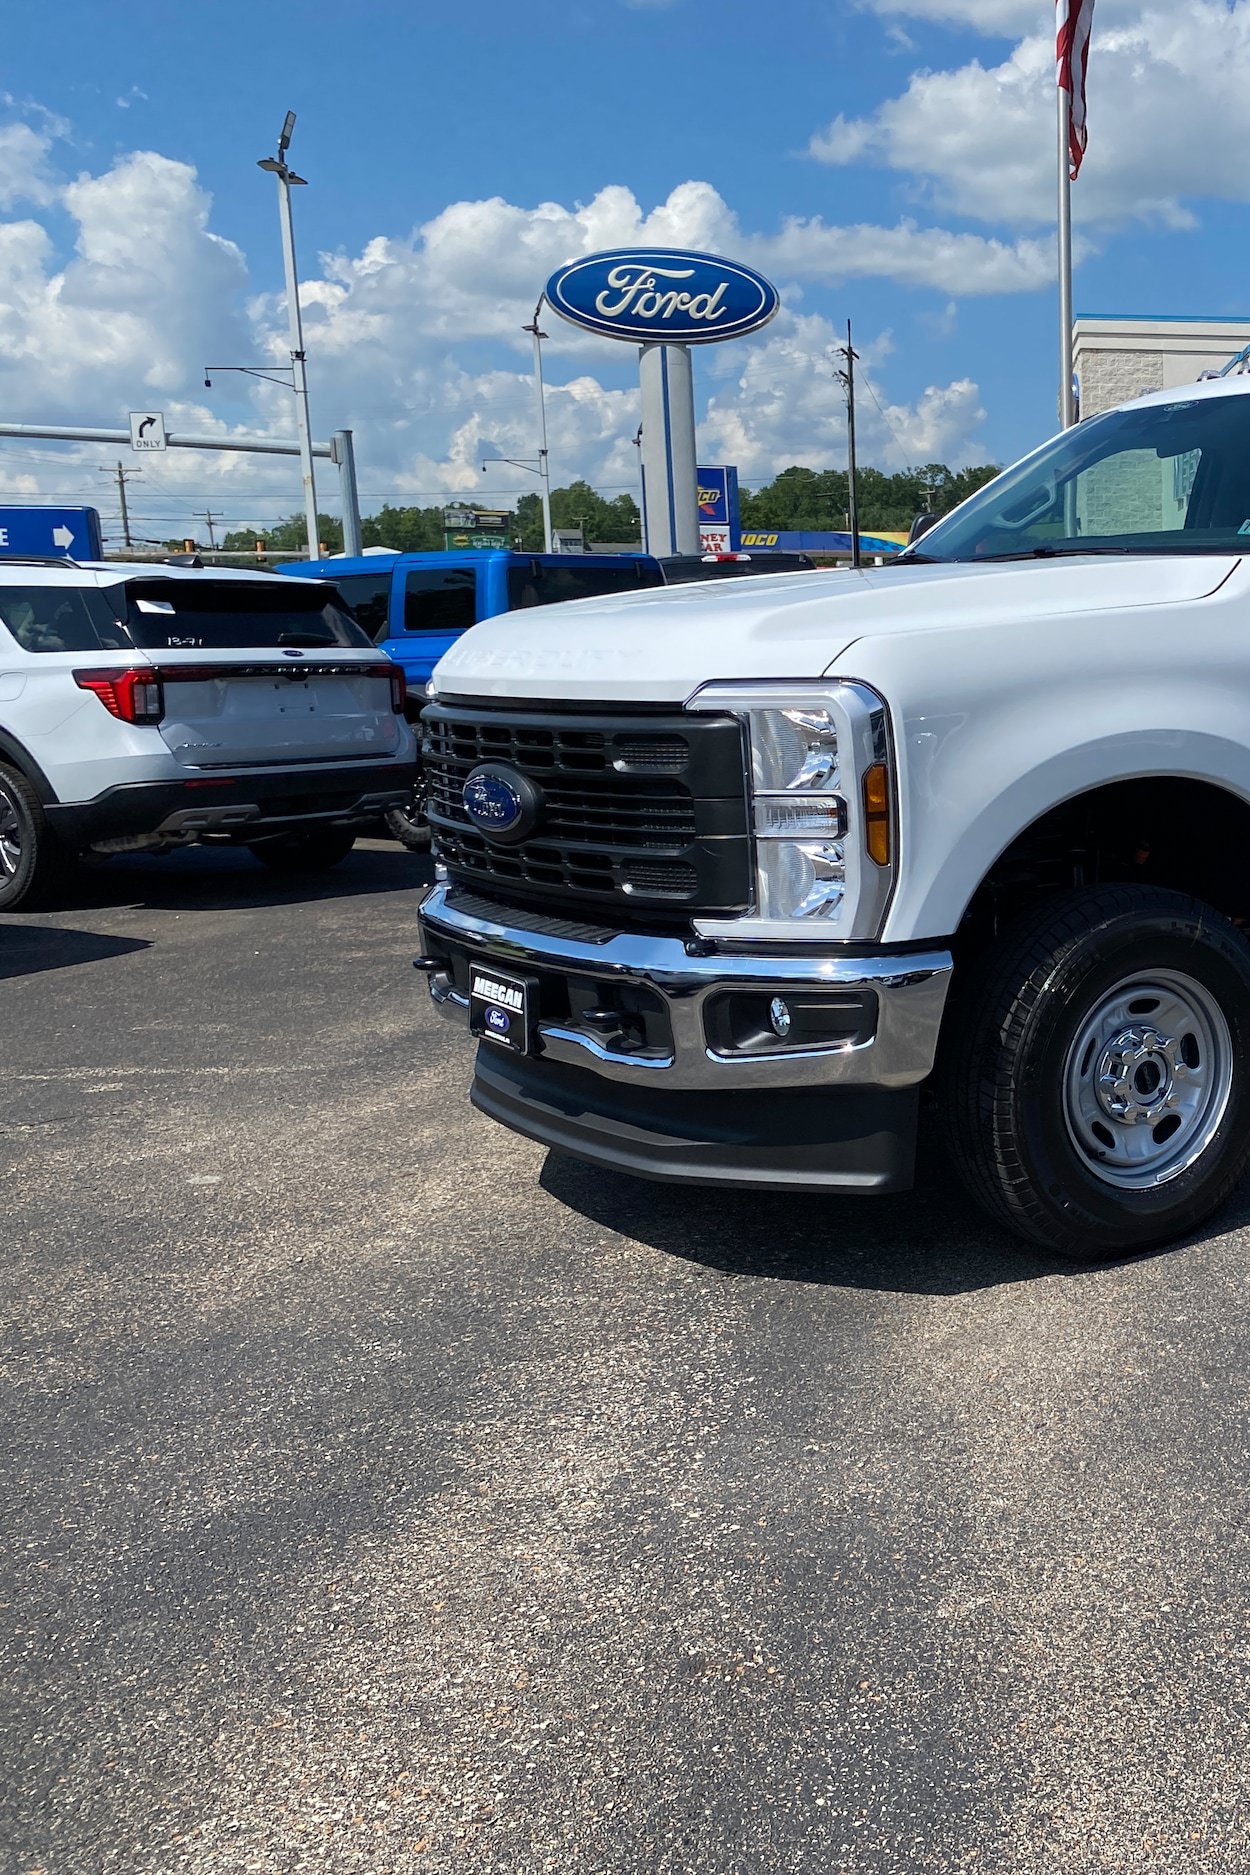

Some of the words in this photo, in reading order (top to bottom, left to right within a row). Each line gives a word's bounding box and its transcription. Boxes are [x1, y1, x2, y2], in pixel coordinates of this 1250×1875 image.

[595, 264, 731, 320] Ford
[136, 440, 160, 448] ONLY
[700, 534, 727, 542] NEY
[473, 976, 523, 1009] MEEGAN
[490, 1010, 505, 1028] Ford
